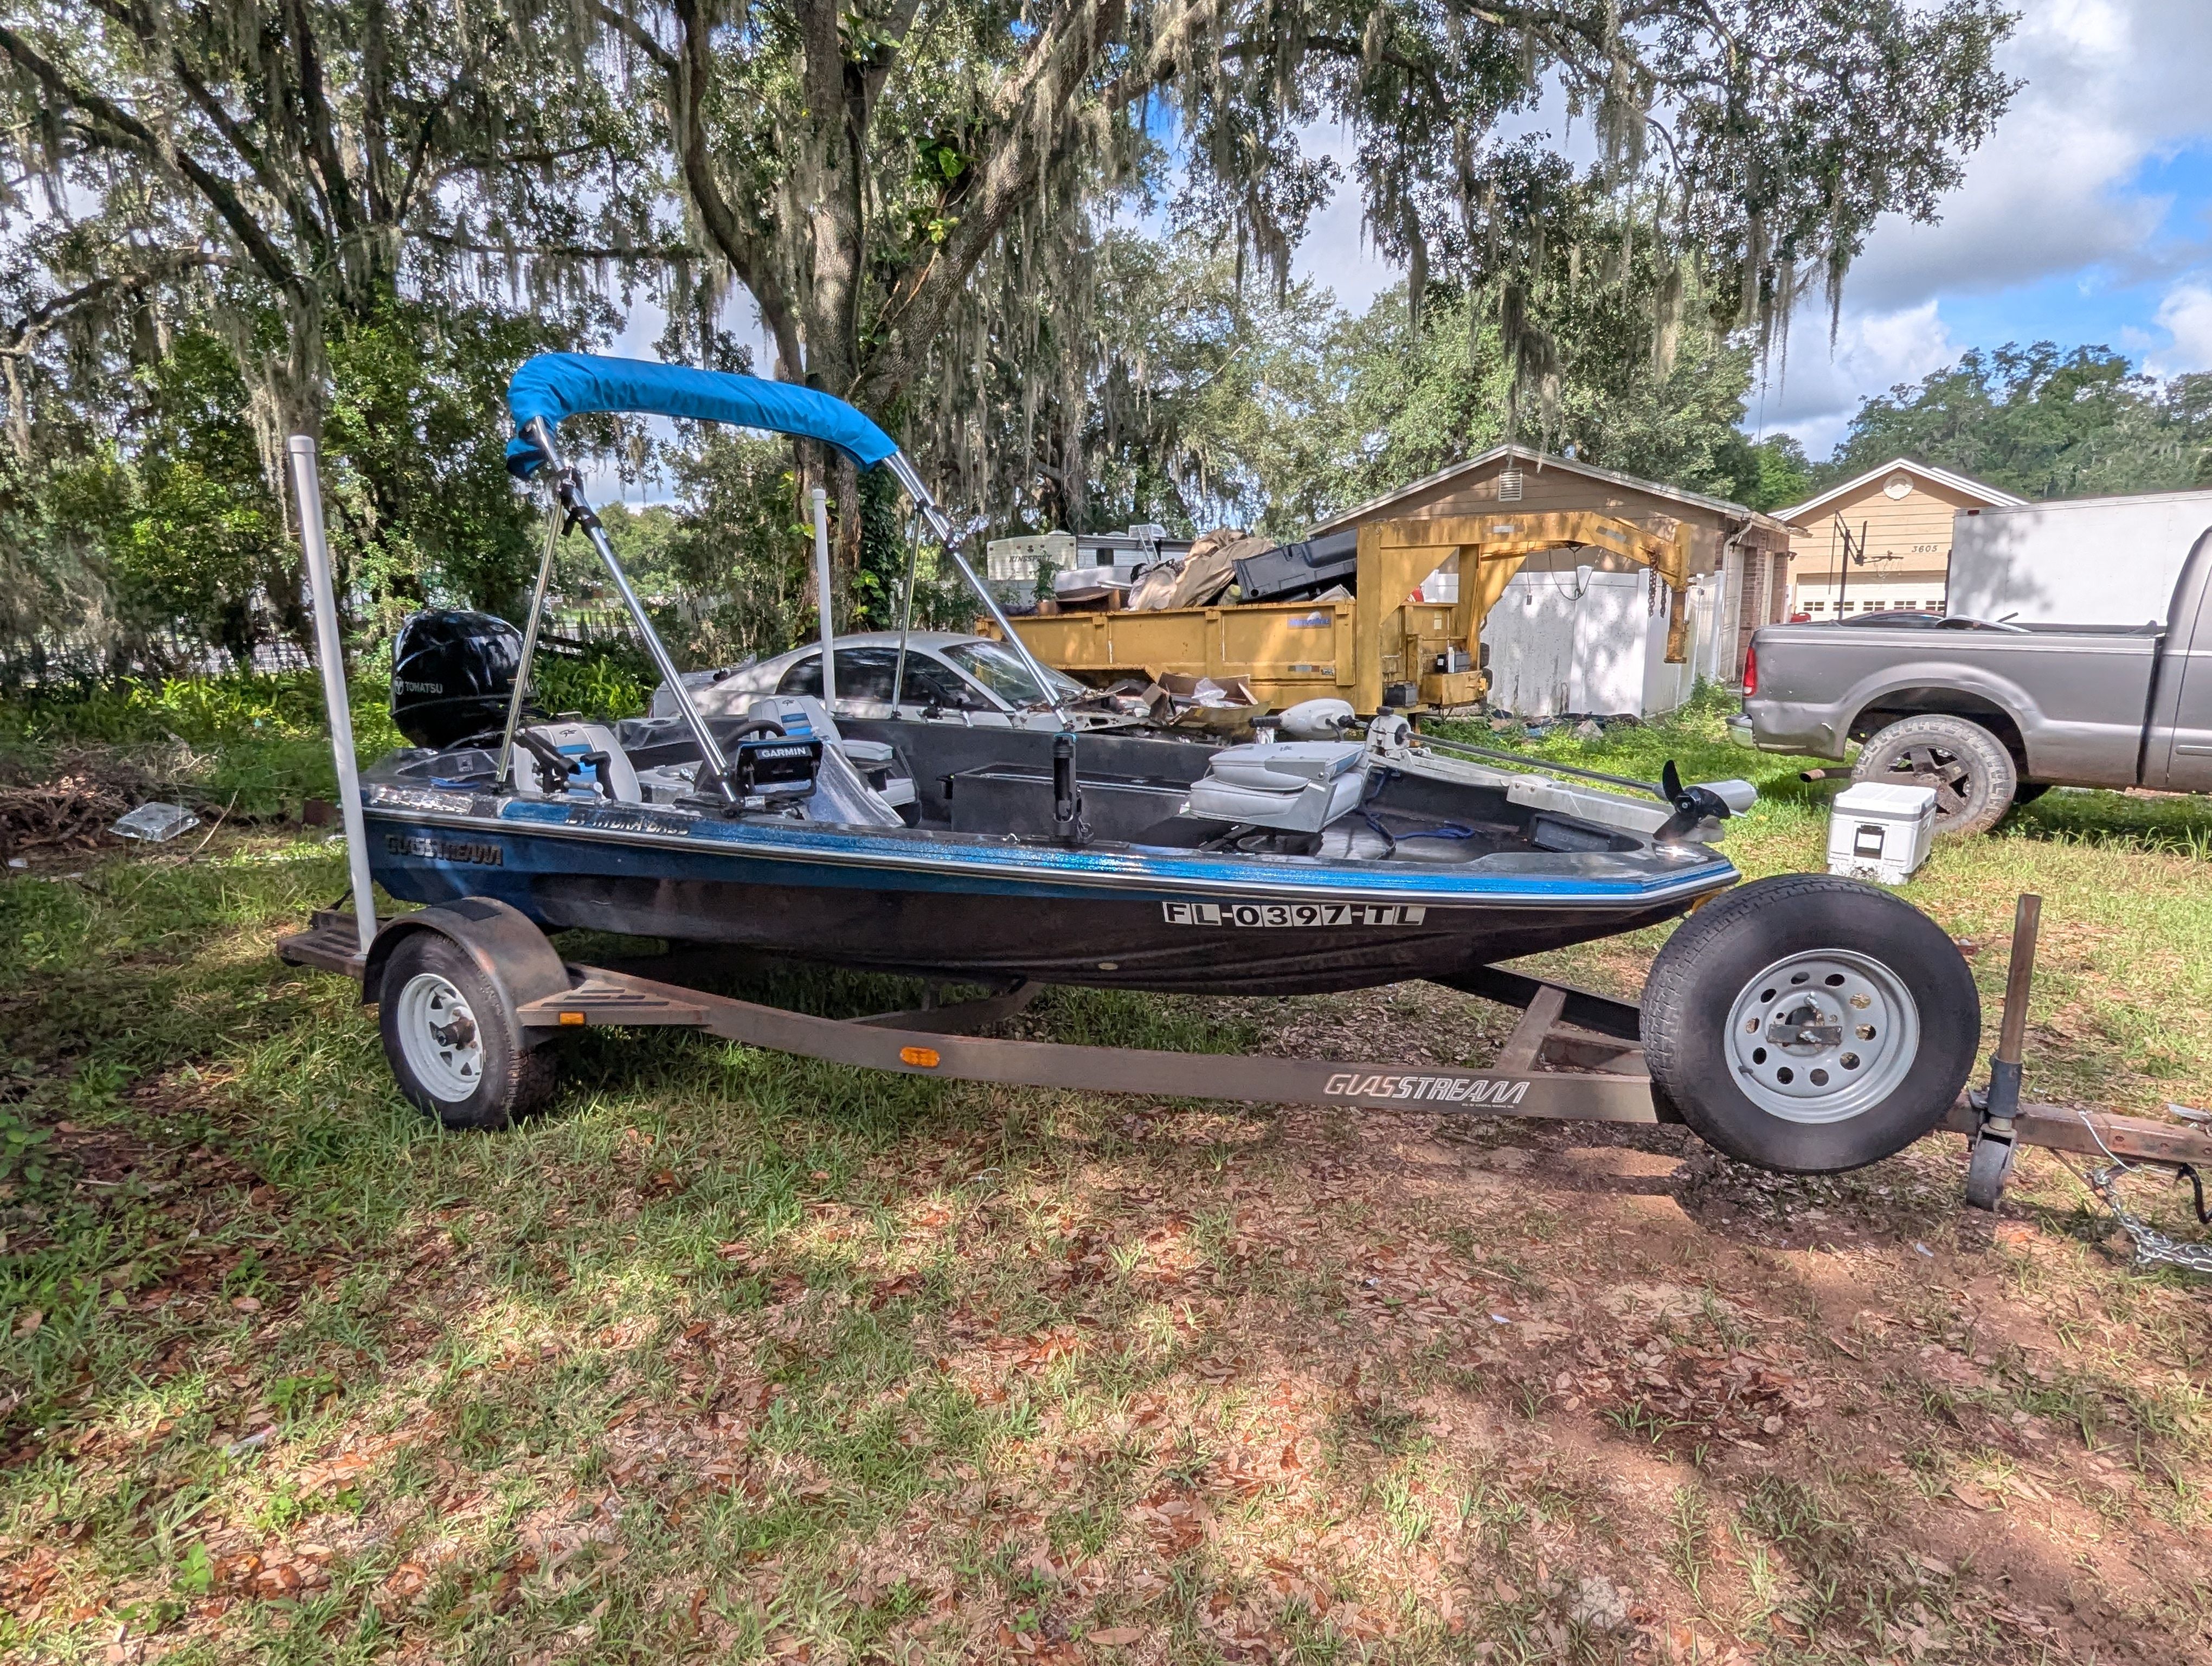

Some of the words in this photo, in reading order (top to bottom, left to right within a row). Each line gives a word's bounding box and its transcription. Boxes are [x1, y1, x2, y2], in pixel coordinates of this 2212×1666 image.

[1911, 544, 1938, 553] 3605
[404, 681, 443, 694] TOHATSU
[761, 747, 807, 758] GARMIN
[1165, 902, 1421, 926] FL-0397-TL
[1323, 1073, 1531, 1104] GLASSTREAM
